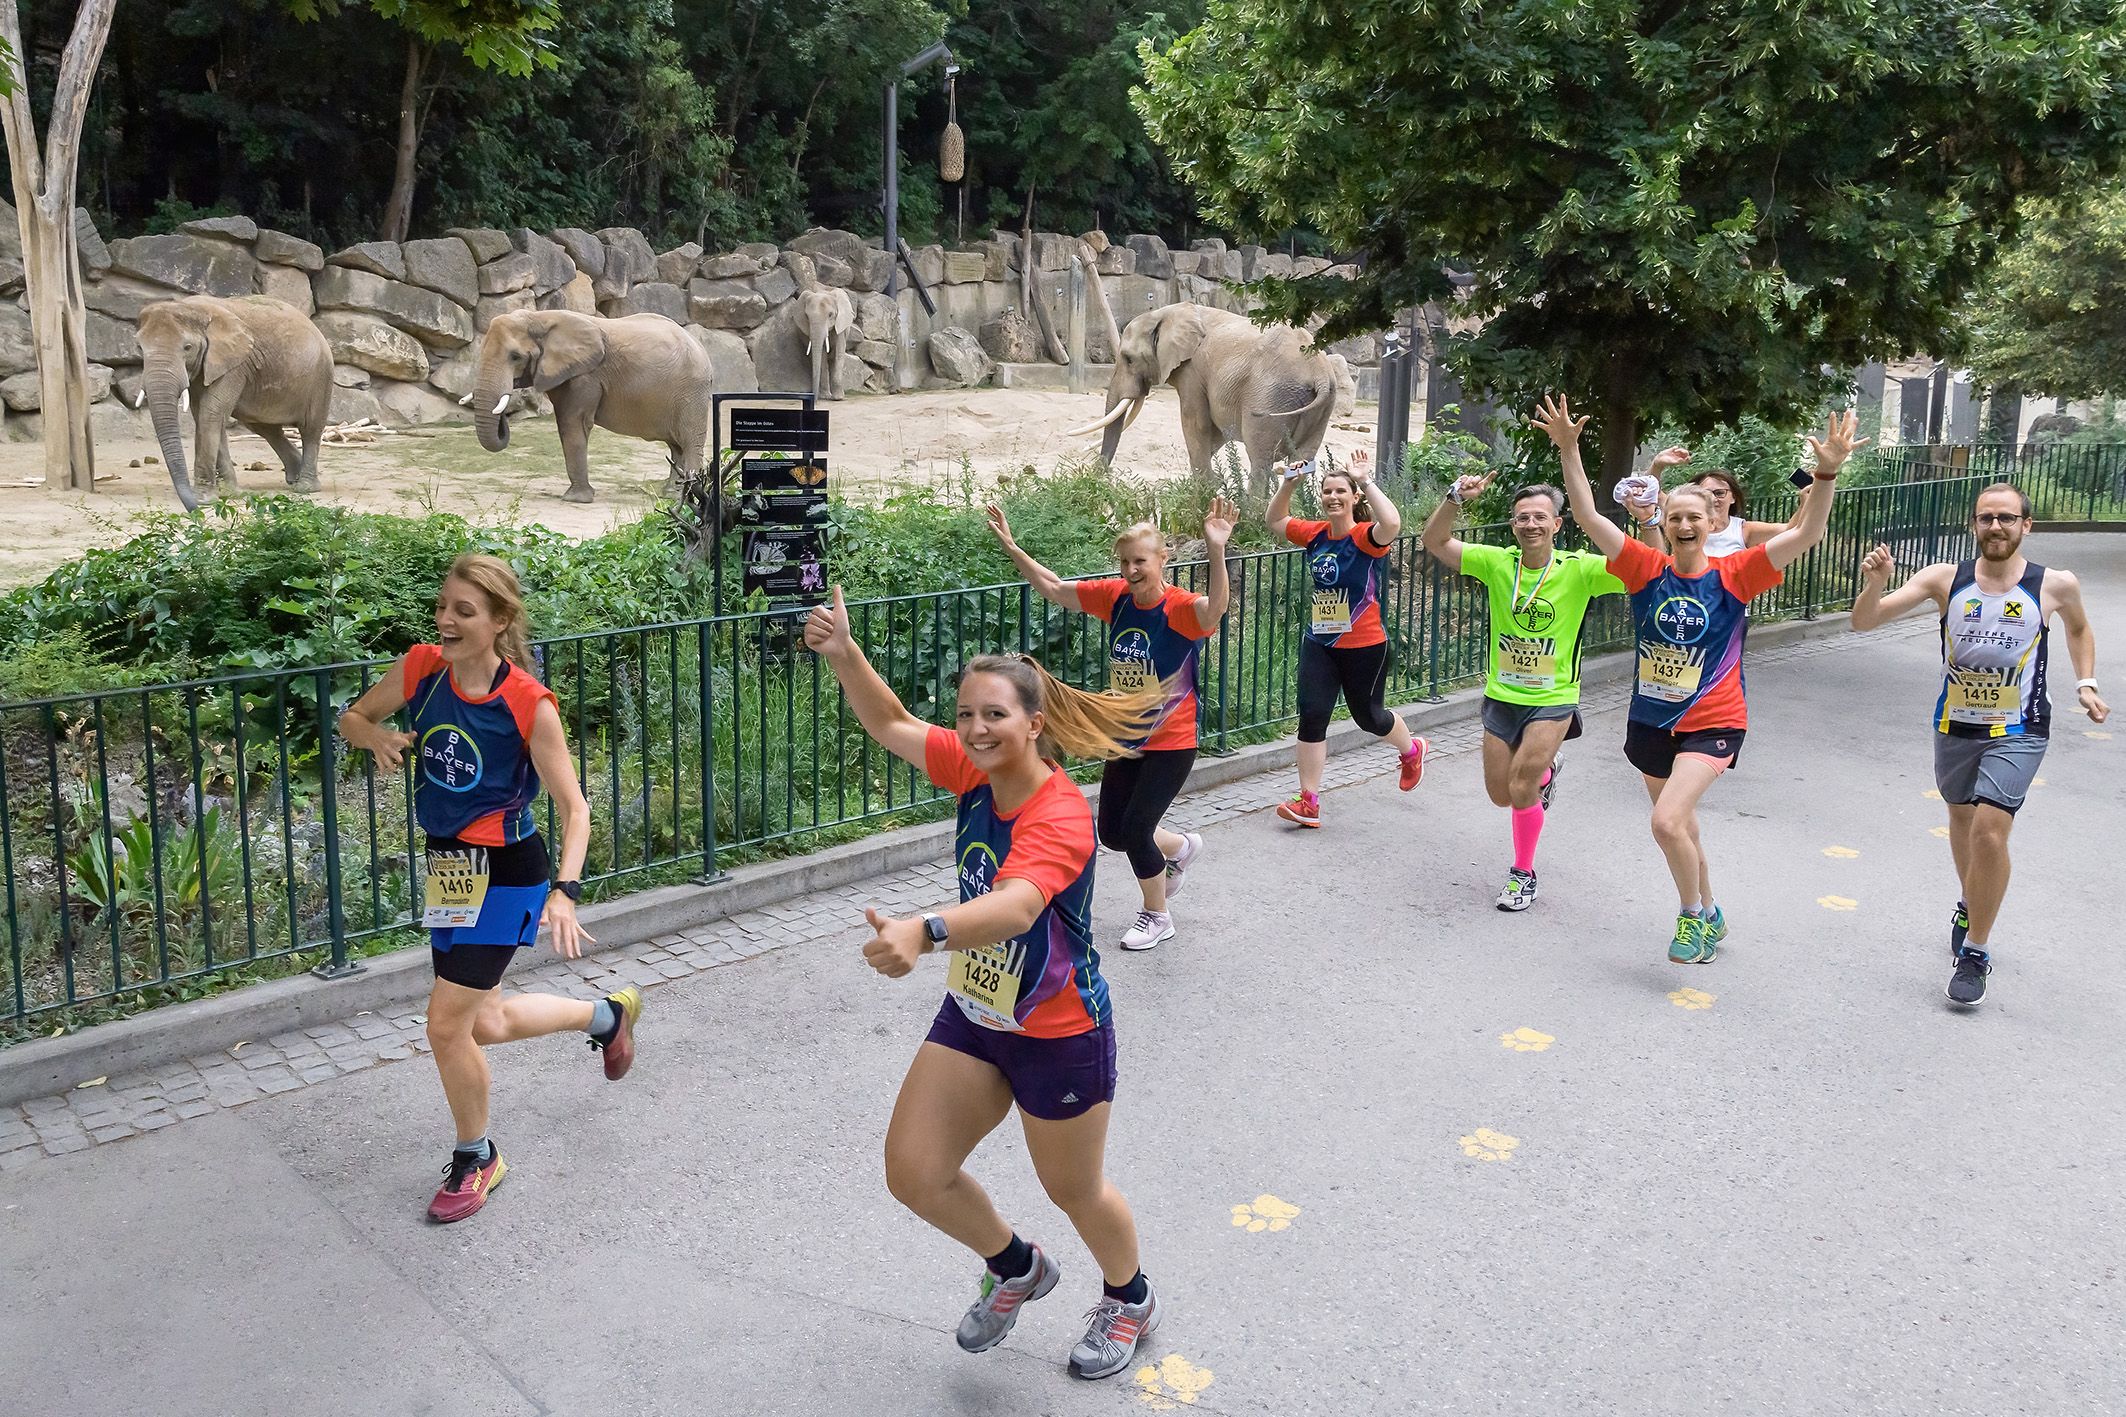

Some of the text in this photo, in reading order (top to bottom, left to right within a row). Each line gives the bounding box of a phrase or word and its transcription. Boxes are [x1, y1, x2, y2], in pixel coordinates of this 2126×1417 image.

[1318, 605, 1337, 615] 1431
[1659, 612, 1705, 627] BAYER
[1675, 600, 1689, 641] BAYER
[1114, 643, 1146, 658] BAYER
[1511, 654, 1539, 667] 1421
[1652, 662, 1684, 679] 1437
[1116, 676, 1145, 688] 1424
[1962, 687, 2000, 701] 1415
[1965, 700, 1997, 708] Gertraud
[424, 745, 476, 776] BAYER
[443, 731, 460, 787] BAYER
[439, 878, 474, 894] 1416
[964, 960, 1000, 993] 1428
[962, 983, 994, 1006] Katharina
